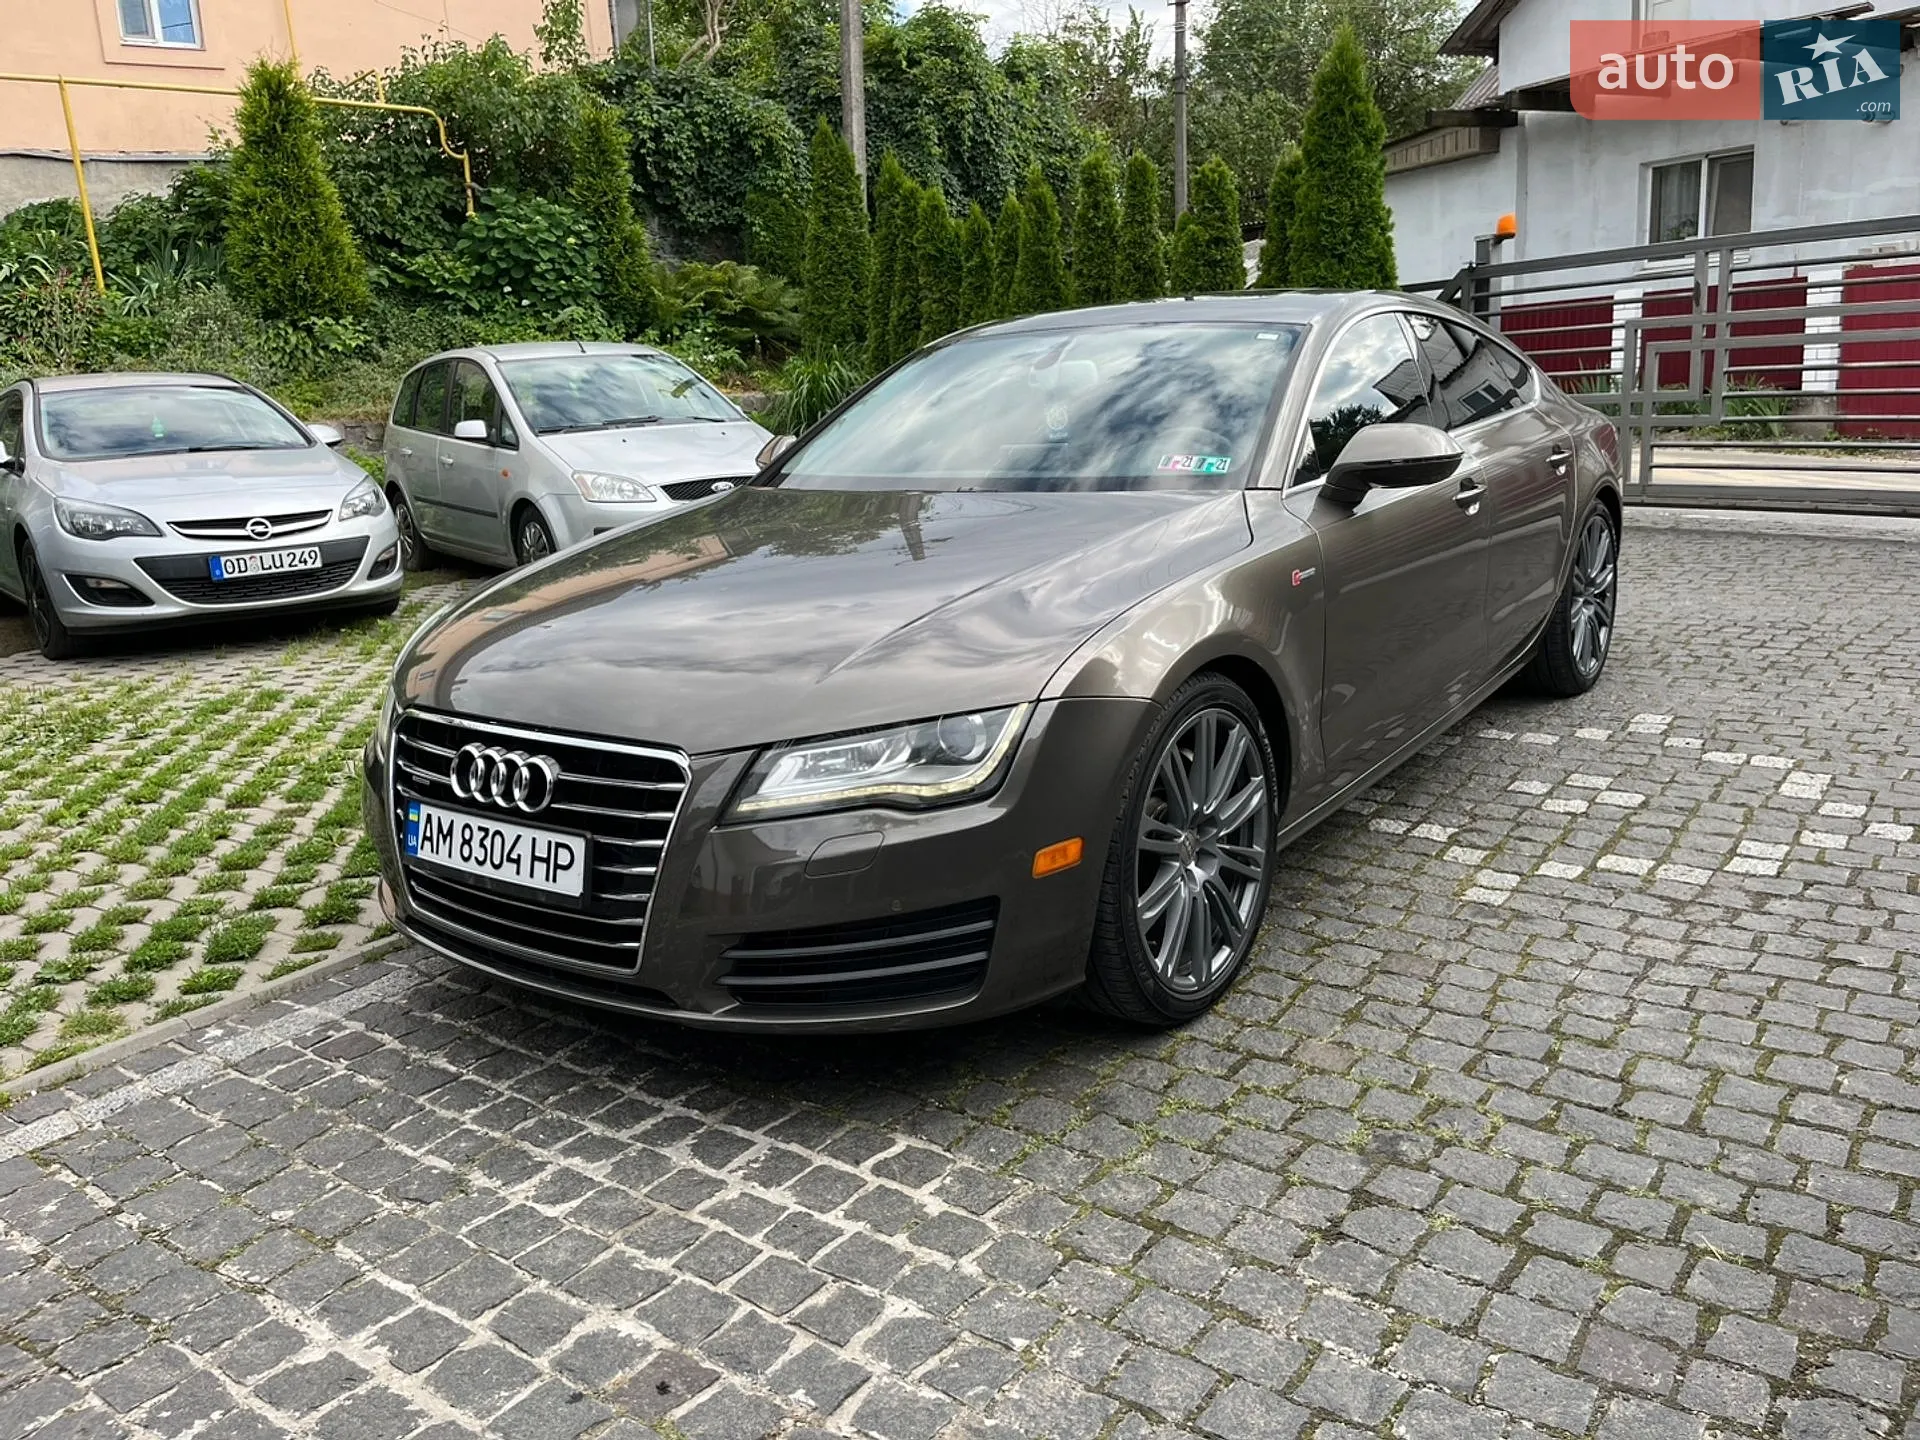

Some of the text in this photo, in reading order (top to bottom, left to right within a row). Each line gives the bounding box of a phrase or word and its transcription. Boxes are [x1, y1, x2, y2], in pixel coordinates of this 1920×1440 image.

[223, 549, 318, 575] OD LU 249
[407, 833, 418, 848] UA
[420, 813, 575, 883] AM 8304 HP
